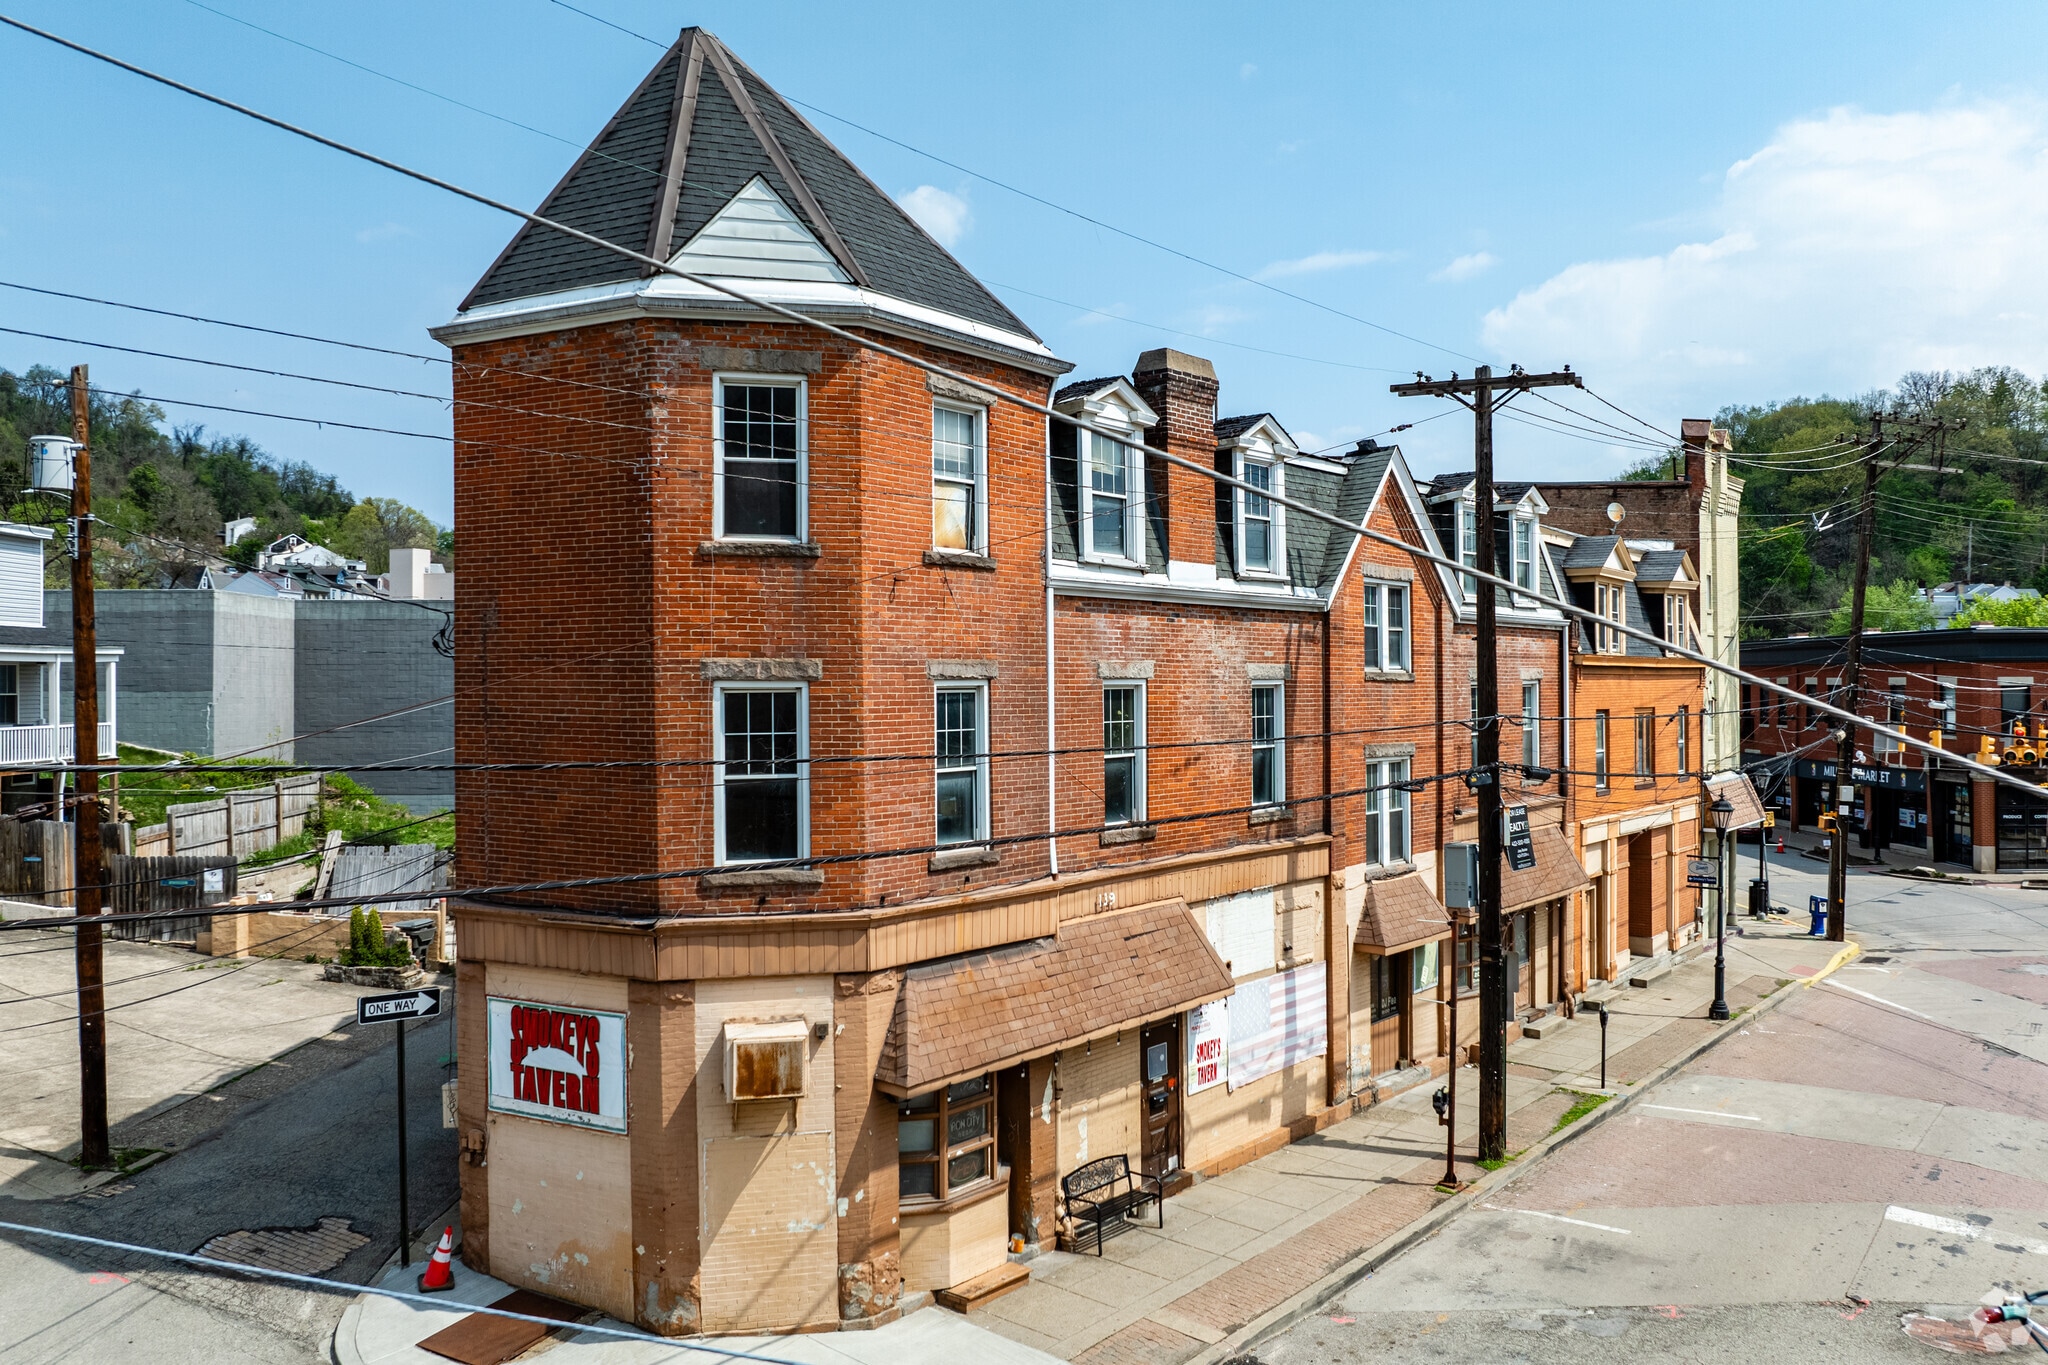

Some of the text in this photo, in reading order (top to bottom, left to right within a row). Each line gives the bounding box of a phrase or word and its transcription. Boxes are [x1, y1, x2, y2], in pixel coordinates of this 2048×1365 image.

[1509, 821, 1525, 832] EALTY
[1098, 892, 1116, 908] 139
[368, 999, 417, 1015] ONE WAY
[510, 1005, 600, 1078] SMOKEYS
[1196, 1037, 1221, 1064] SMOKEY'S
[1197, 1062, 1218, 1086] TAVERN
[510, 1062, 600, 1115] TAVERN
[966, 1115, 981, 1128] CITY
